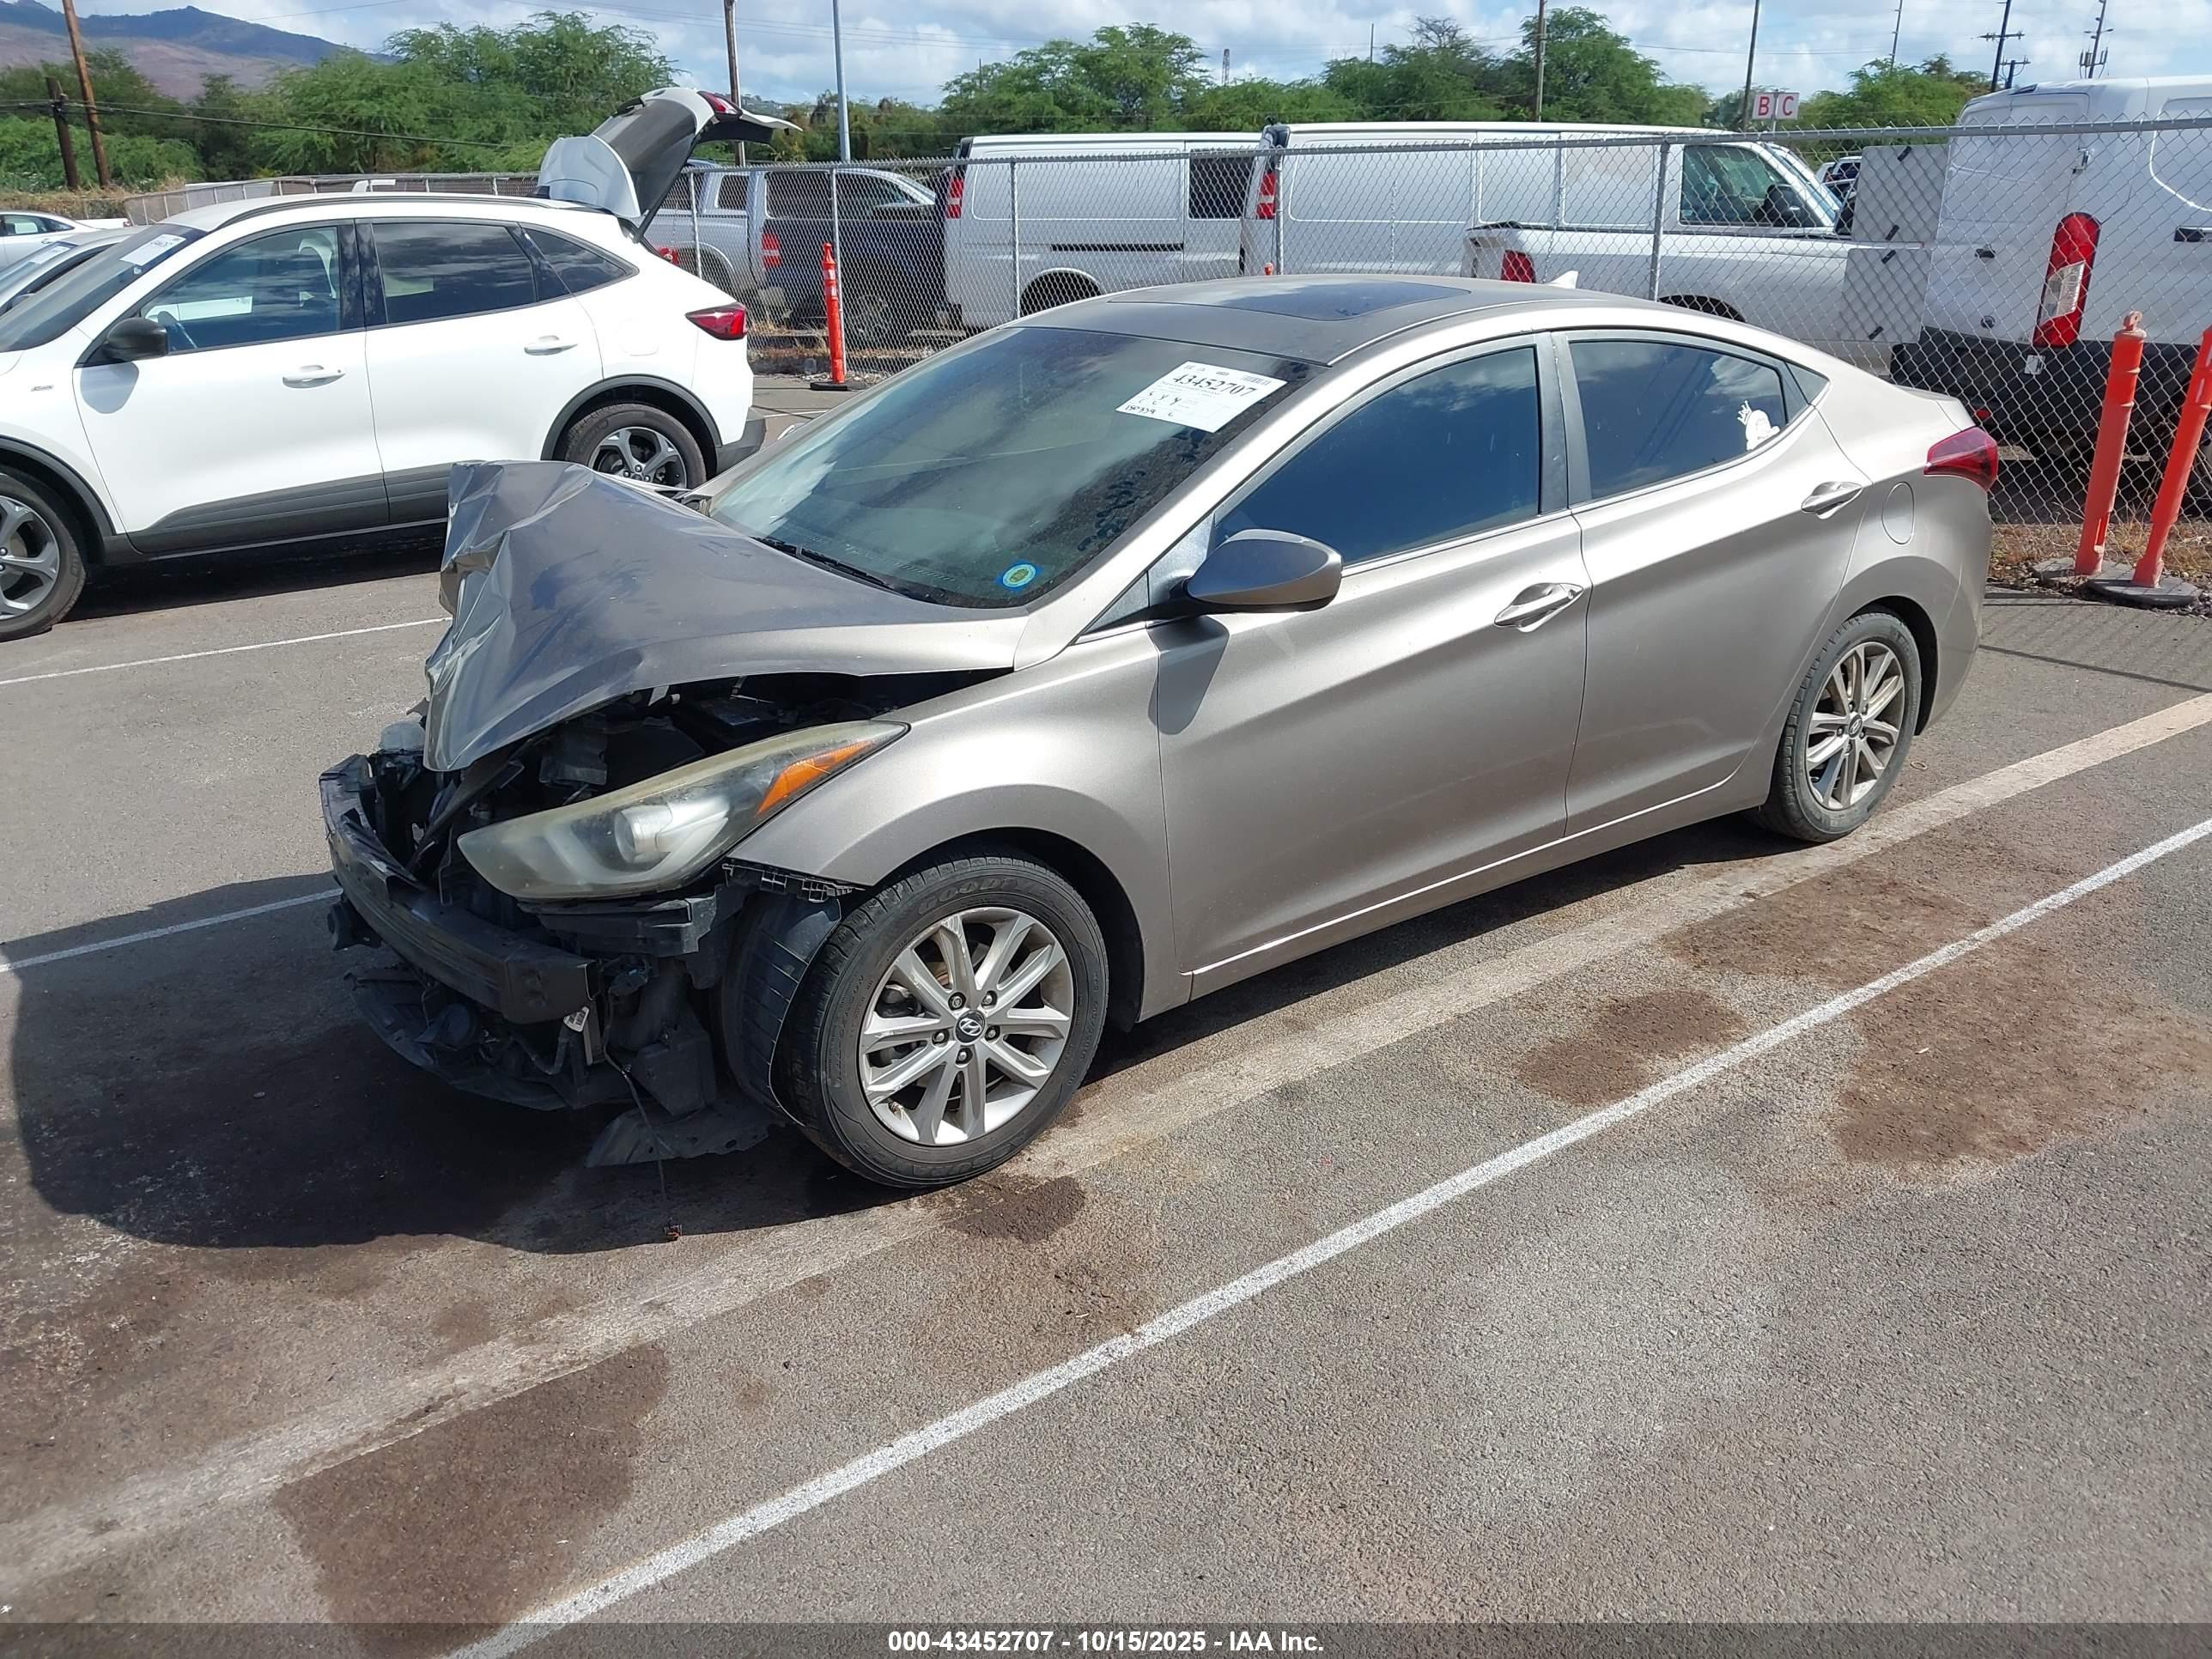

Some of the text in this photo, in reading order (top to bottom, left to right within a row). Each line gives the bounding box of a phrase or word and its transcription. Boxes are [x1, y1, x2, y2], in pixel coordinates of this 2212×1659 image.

[1758, 95, 1794, 116] B C
[1173, 373, 1257, 397] 43452707
